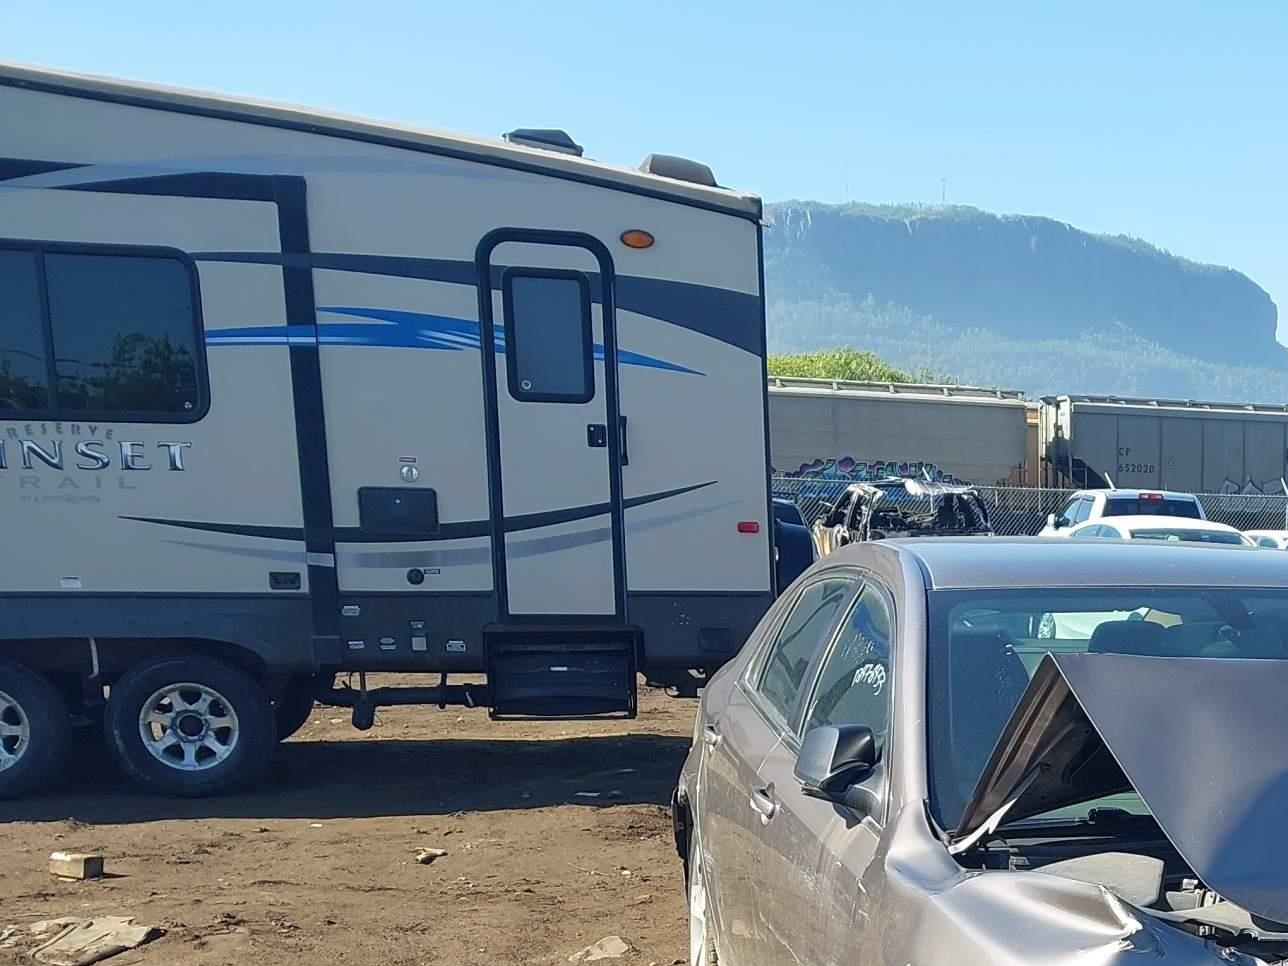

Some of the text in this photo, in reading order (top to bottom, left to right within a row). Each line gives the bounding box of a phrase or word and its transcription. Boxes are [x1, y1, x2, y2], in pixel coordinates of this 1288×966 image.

[6, 422, 115, 440] RESERVE
[0, 439, 193, 472] NSET
[1118, 447, 1132, 457] CP
[0, 475, 139, 490] RAIL
